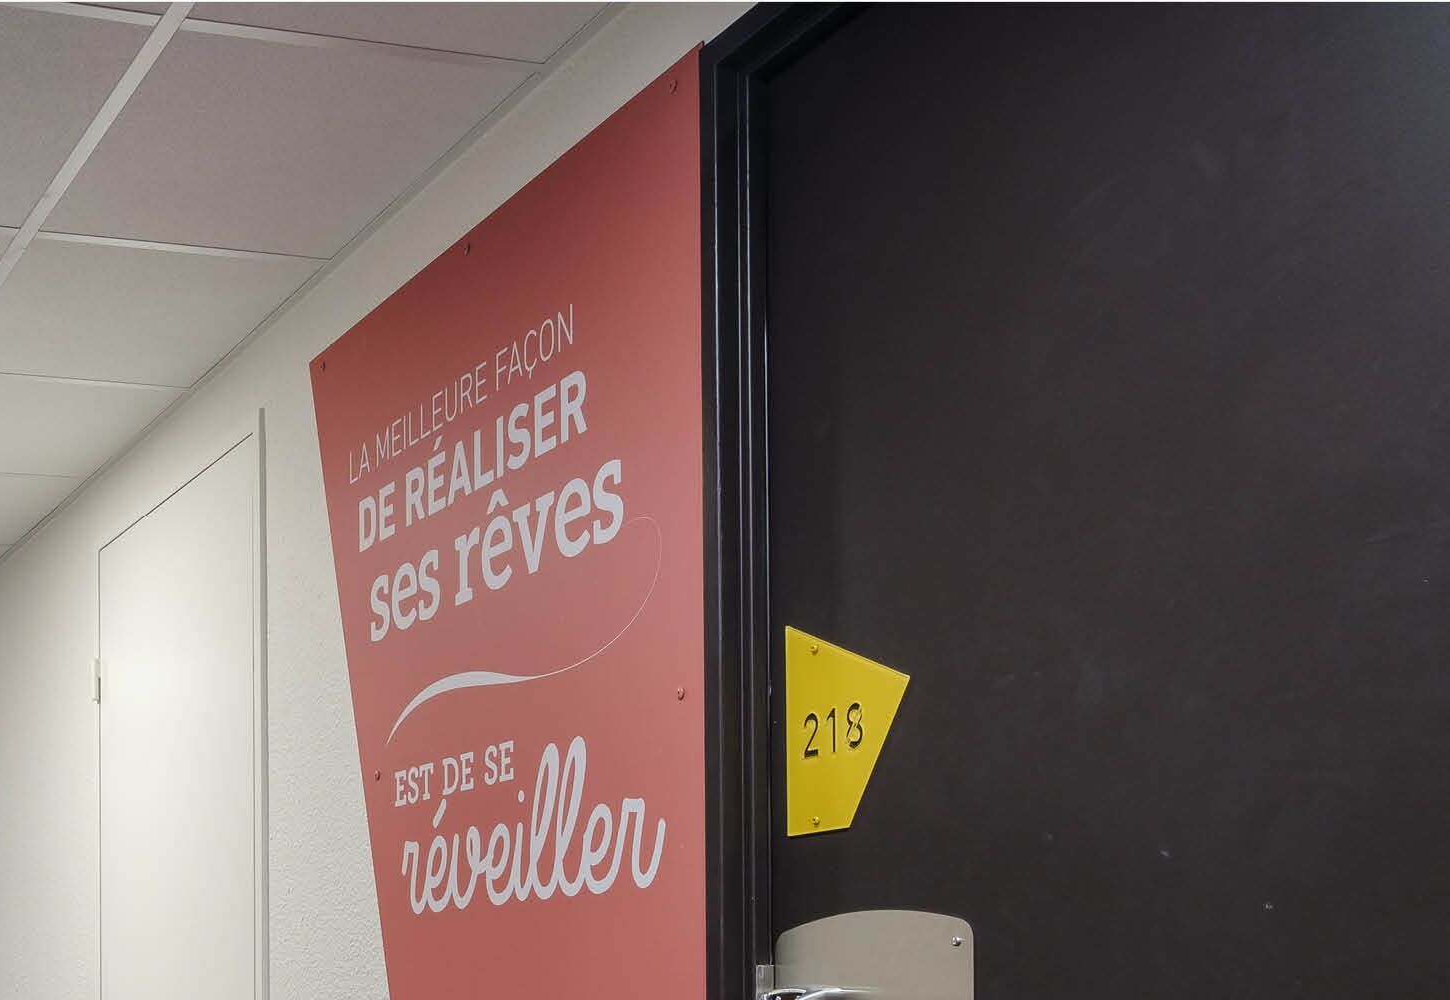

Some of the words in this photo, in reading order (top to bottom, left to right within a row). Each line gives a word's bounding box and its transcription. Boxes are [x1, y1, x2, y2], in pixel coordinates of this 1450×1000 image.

[349, 450, 371, 485] LA
[376, 360, 487, 467] MEILLEURE
[496, 303, 575, 391] FAÇON
[358, 481, 396, 552] DE
[405, 370, 589, 527] RÉALISER
[370, 549, 441, 642] ses
[454, 459, 625, 606] rêves
[395, 762, 434, 807] EST
[442, 751, 474, 796] DE
[484, 740, 515, 786] SE
[803, 702, 863, 759] 218
[401, 735, 666, 914] réveiller
